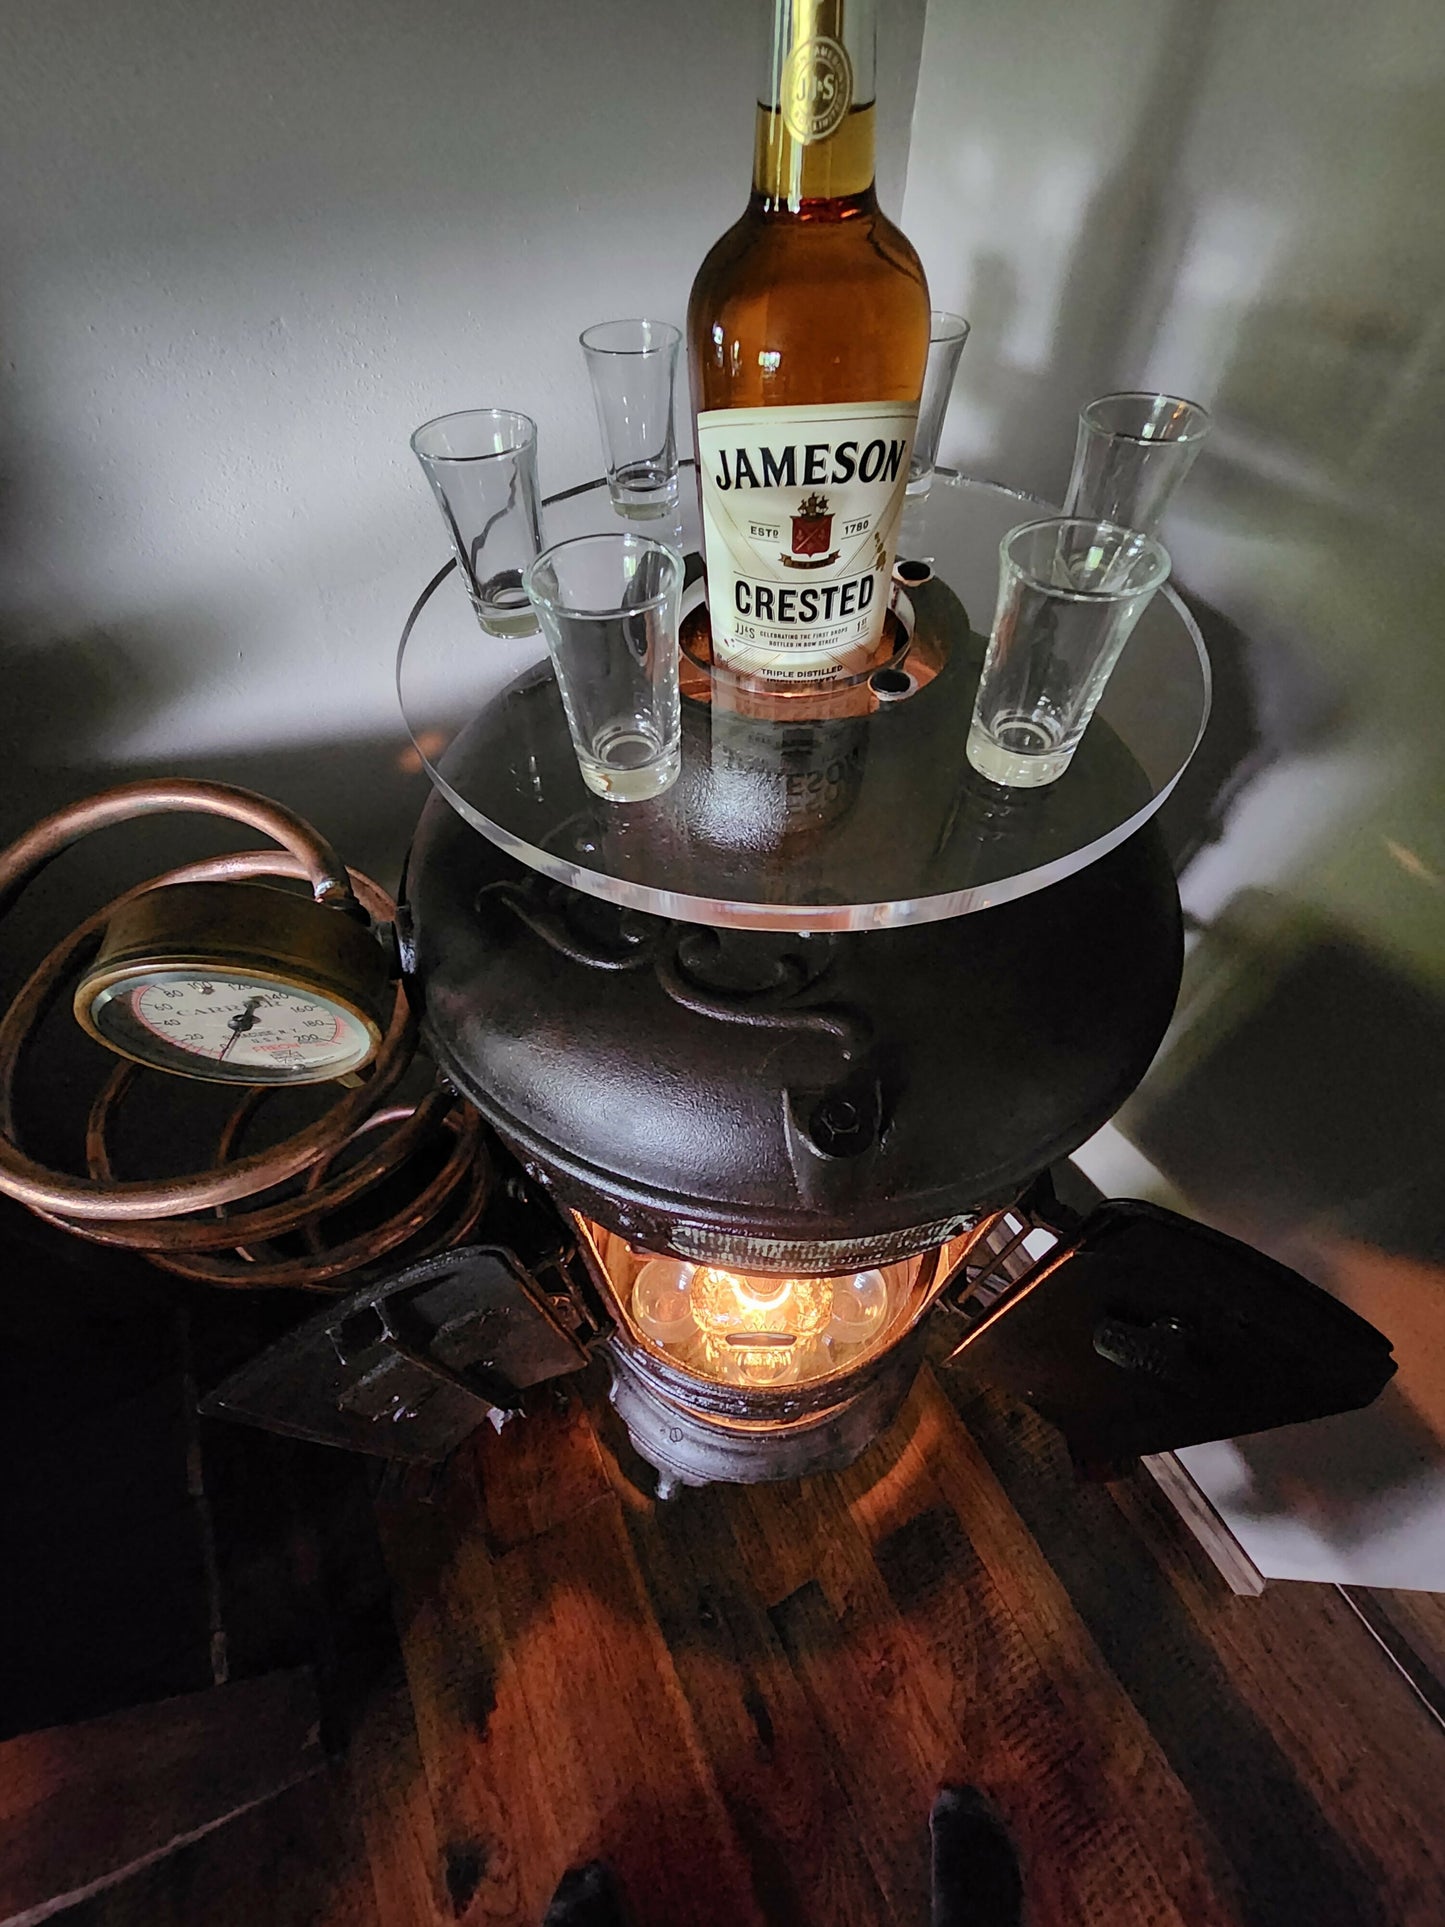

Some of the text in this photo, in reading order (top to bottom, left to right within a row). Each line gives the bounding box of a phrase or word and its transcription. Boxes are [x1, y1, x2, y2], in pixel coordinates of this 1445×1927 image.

[716, 439, 907, 490] JAMESON
[844, 520, 869, 534] 1780
[735, 574, 875, 623] CRESTED
[760, 631, 798, 640] CELEBRATING
[813, 630, 829, 639] FIRST
[831, 627, 848, 636] DROPS
[769, 640, 794, 648] BOTTLED
[819, 637, 839, 646] STREET
[761, 665, 844, 678] TRIPLE DISTILLED
[164, 989, 184, 998] 80
[265, 993, 288, 1001] 140
[154, 1003, 174, 1011] 60
[290, 1005, 314, 1014] 160
[302, 1019, 325, 1027] 180
[293, 1033, 319, 1043] 200
